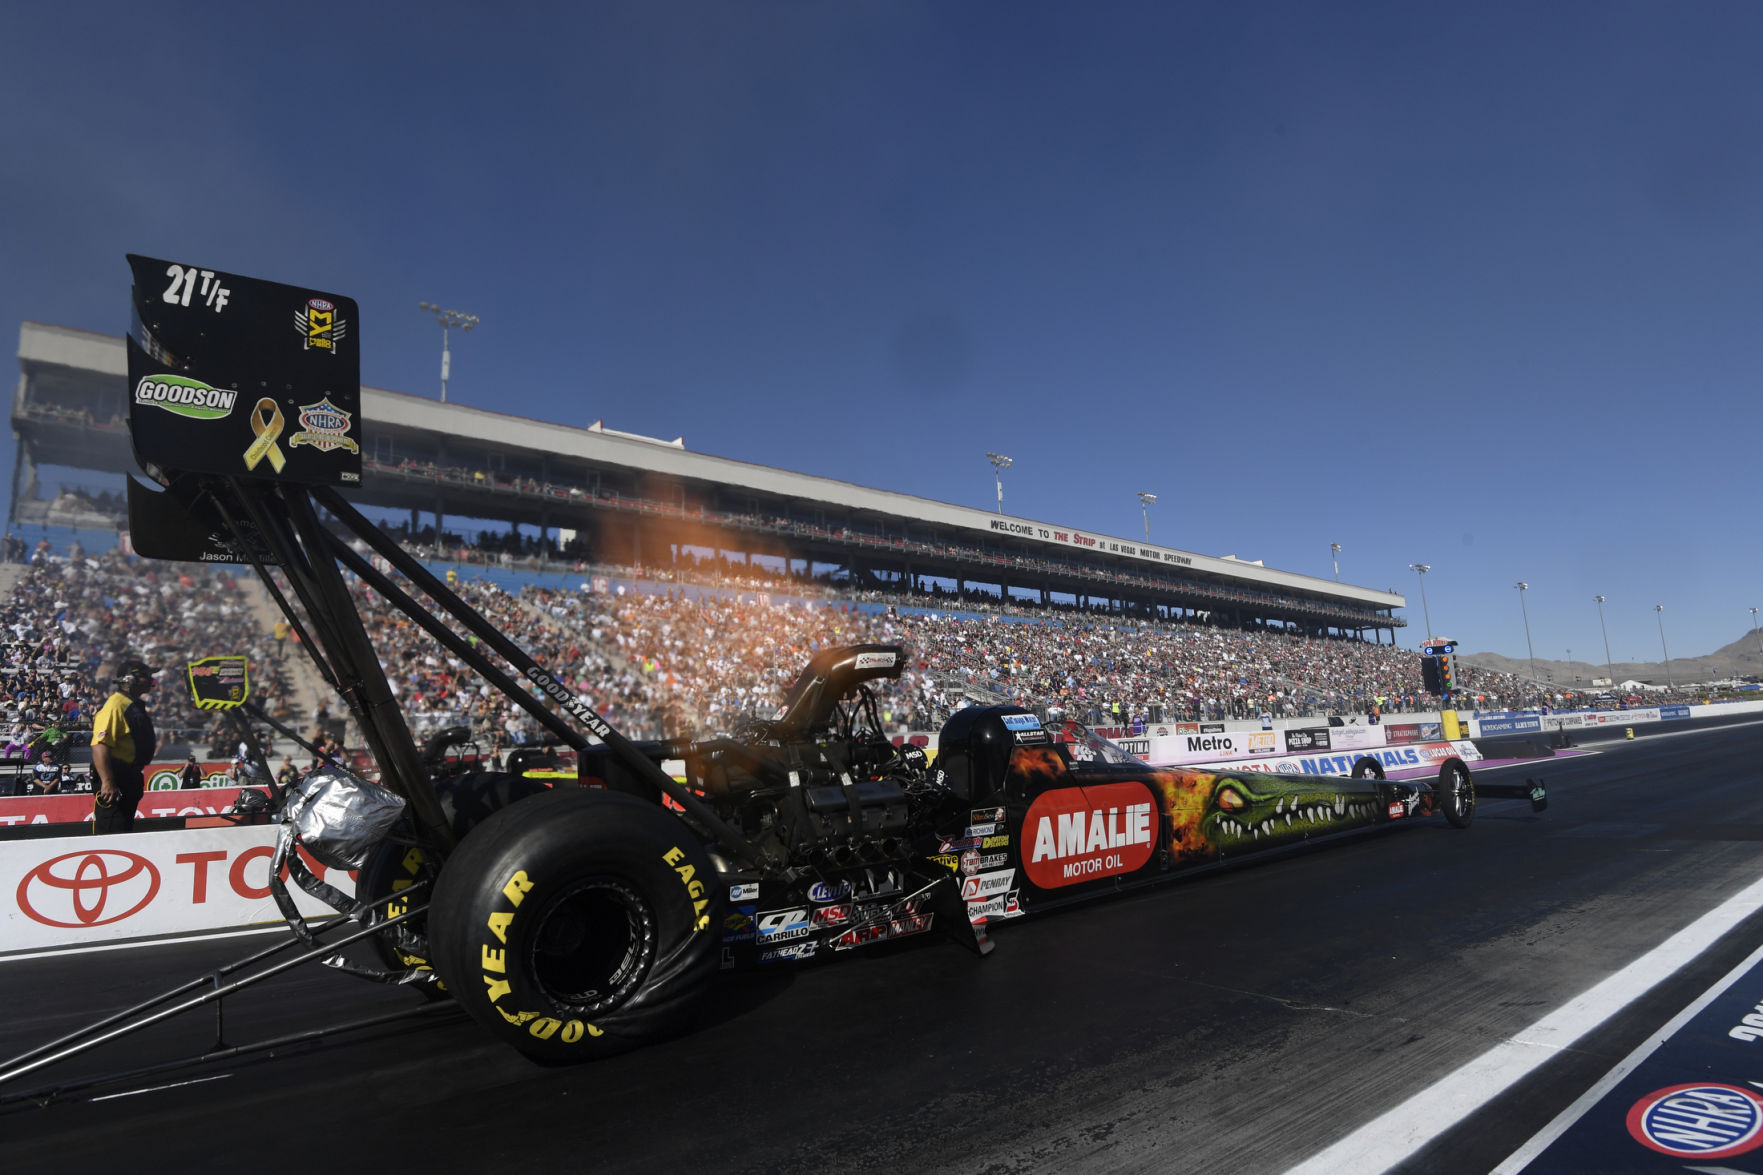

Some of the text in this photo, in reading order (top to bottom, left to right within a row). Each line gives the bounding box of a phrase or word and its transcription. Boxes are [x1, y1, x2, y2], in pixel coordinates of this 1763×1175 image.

[163, 264, 230, 313] 21 T/F
[139, 381, 234, 409] GOODSON
[309, 415, 342, 429] NHRA
[990, 519, 1033, 536] WELCOME
[1038, 528, 1050, 539] TO
[1054, 531, 1069, 542] THE
[1109, 543, 1119, 552] LAS
[1121, 545, 1135, 555] VEGAS
[1140, 548, 1160, 560] MOTOR
[199, 552, 233, 561] Jason
[1187, 736, 1232, 752] Metro
[905, 750, 923, 759] MSD
[1032, 803, 1150, 863] AMALIE
[980, 853, 1007, 864] BRAKES
[1064, 854, 1123, 878] MOTOR OIL
[742, 887, 758, 895] Miller
[812, 904, 852, 924] MSD
[968, 901, 1003, 917] CHAMPION
[757, 927, 809, 944] CARRILLO
[1651, 1091, 1752, 1148] NHRA
